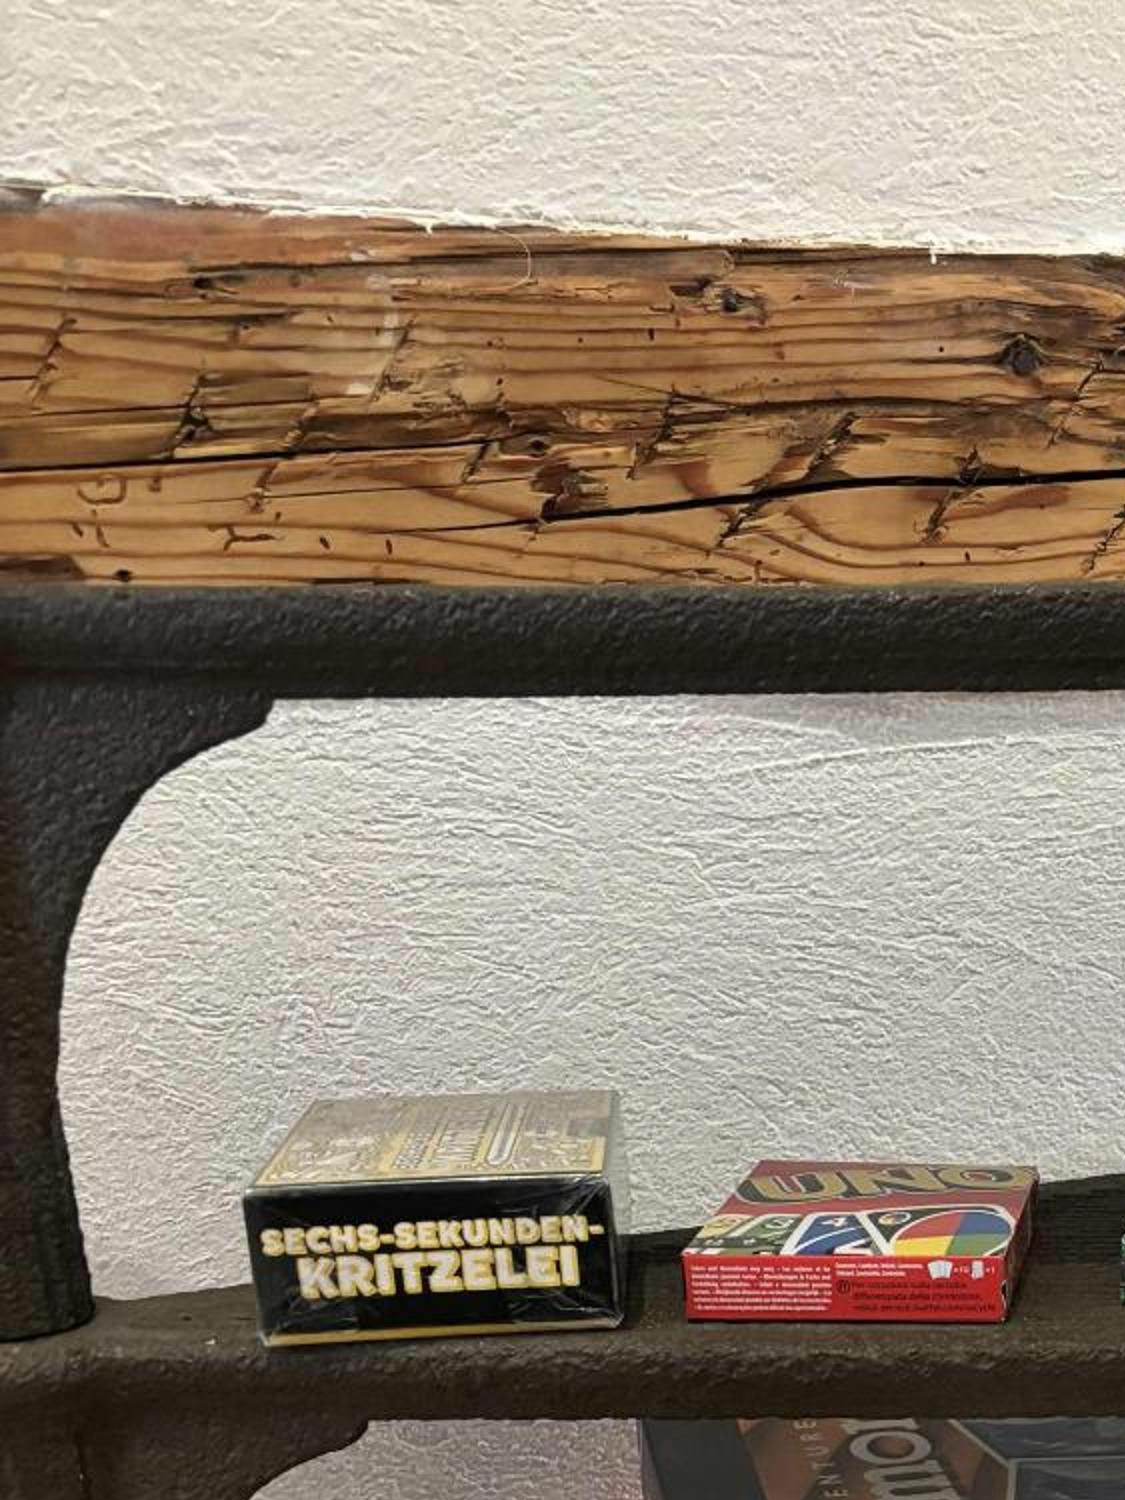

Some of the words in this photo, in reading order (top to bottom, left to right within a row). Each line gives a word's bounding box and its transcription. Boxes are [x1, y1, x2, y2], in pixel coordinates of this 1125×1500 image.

[737, 1165, 1038, 1203] UNO
[260, 1214, 605, 1257] SECHS-SEKUNDEN-
[297, 1245, 581, 1300] KRITZELEI
